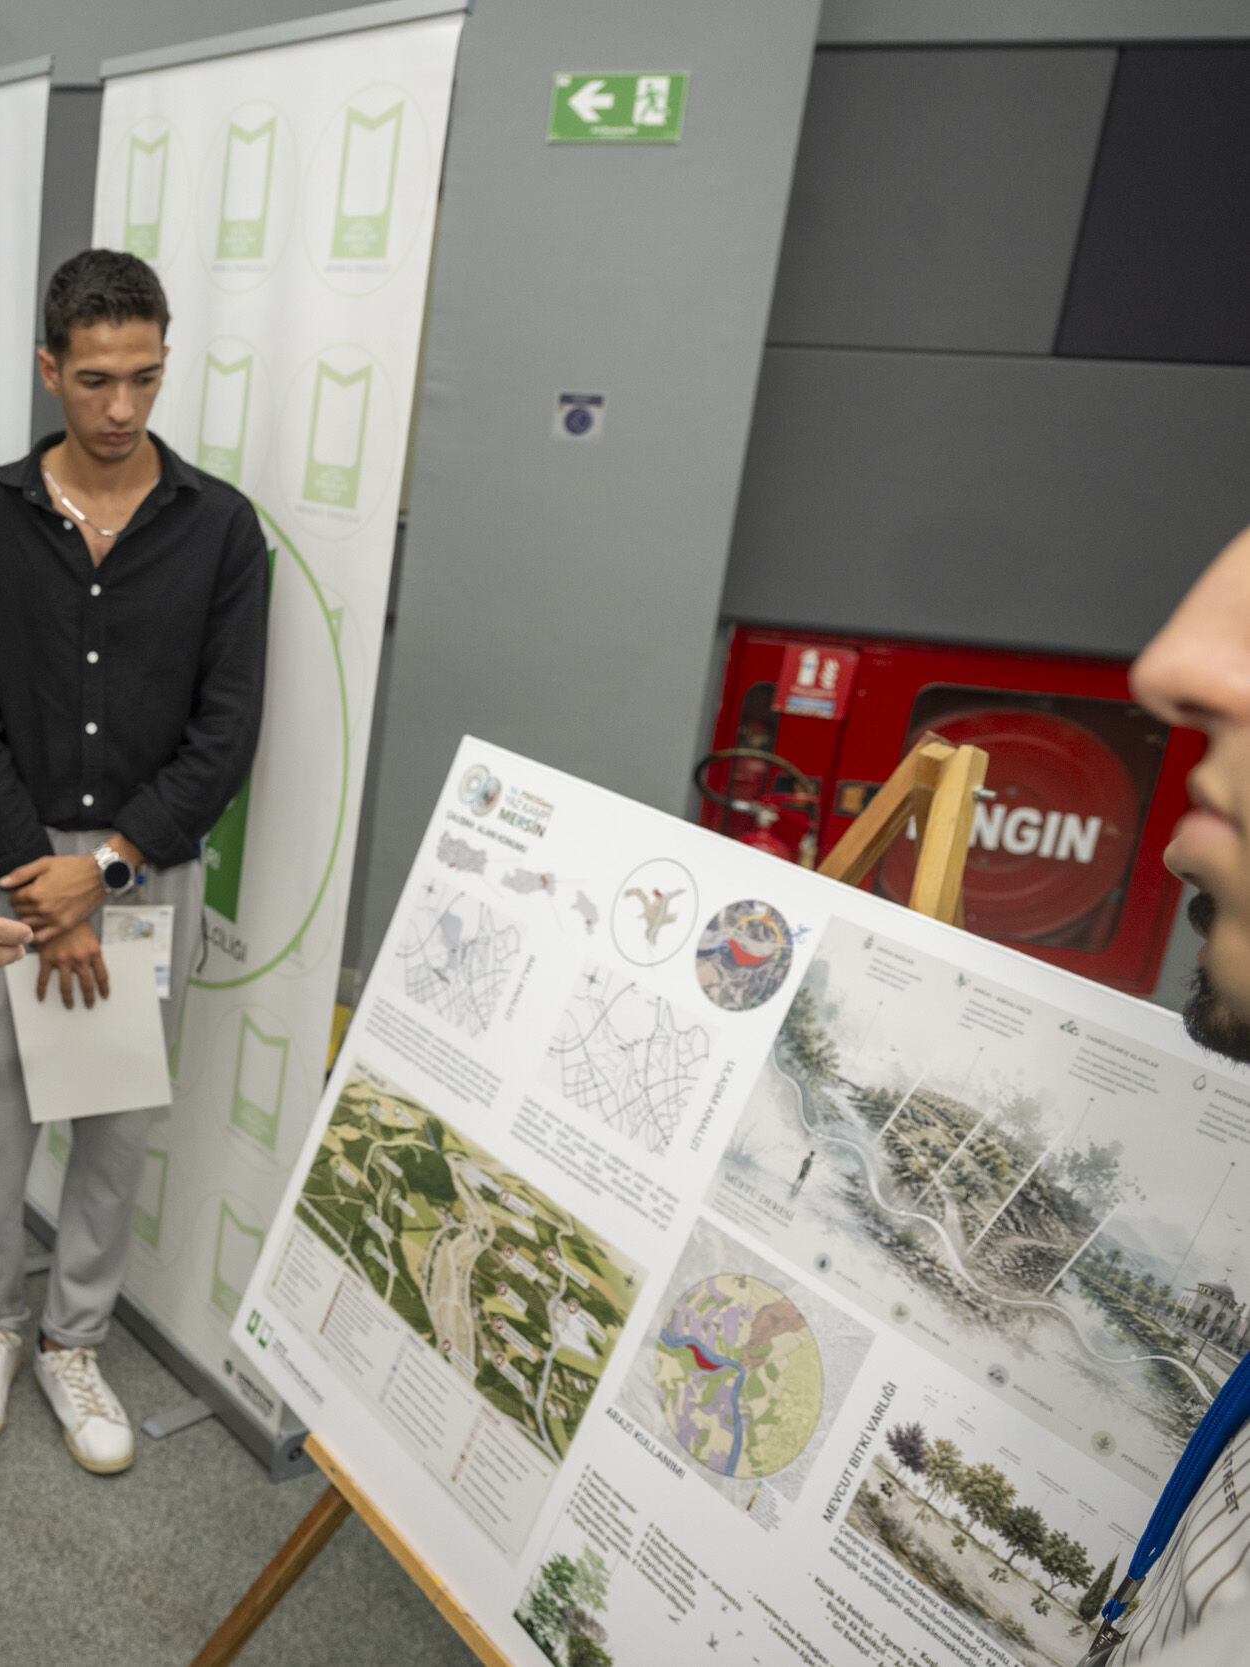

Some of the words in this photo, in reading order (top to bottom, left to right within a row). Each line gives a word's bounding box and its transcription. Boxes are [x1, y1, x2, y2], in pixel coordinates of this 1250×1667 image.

[822, 1468, 854, 1524] MEVCUT
[848, 1432, 872, 1469] BİTKİ
[865, 1381, 897, 1432] VARLIĞI
